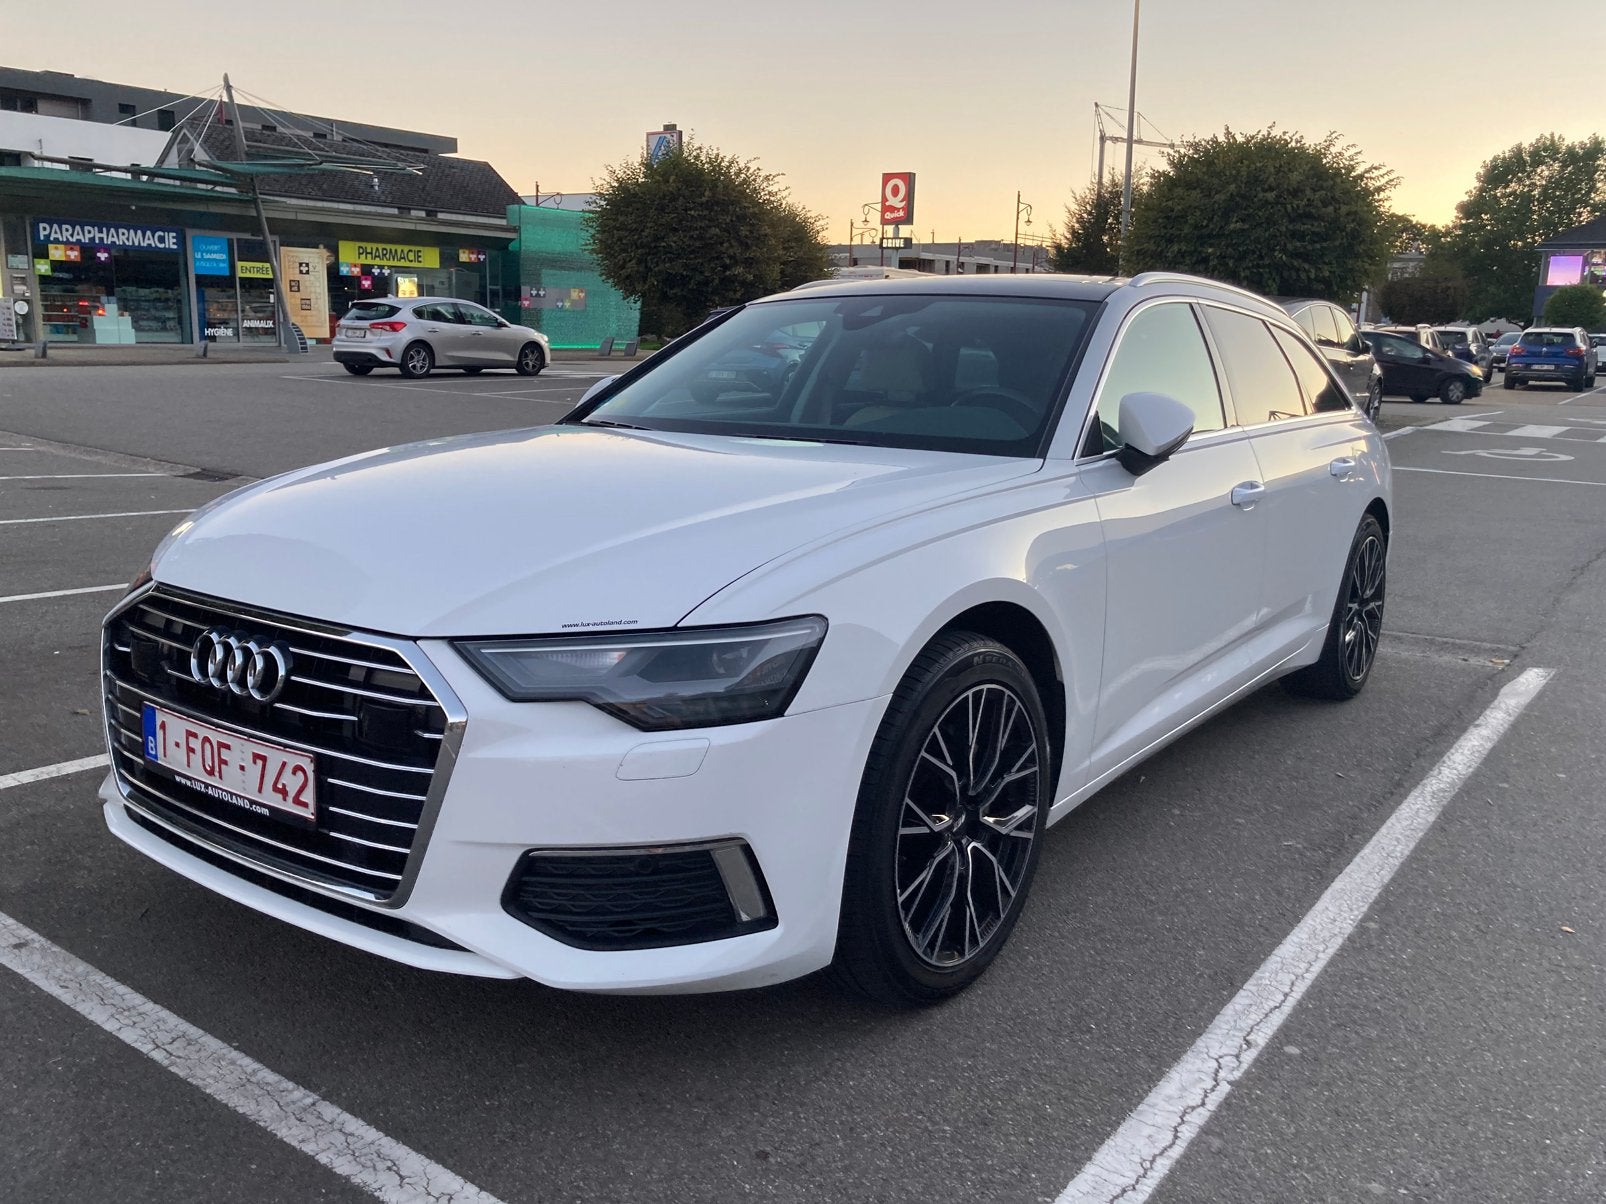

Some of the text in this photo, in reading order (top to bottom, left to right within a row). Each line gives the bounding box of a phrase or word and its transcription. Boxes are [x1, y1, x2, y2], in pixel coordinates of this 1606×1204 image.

[884, 209, 904, 219] Quick
[38, 222, 178, 249] PARAPHARMACIE
[882, 239, 905, 248] DRIVE
[357, 245, 423, 264] PHARMACIE
[240, 264, 270, 276] ENTRÉE
[243, 320, 274, 328] ANIMAUX
[204, 326, 233, 337] HYGIÈNE
[561, 620, 638, 628] www.lux-autoland.com
[148, 736, 156, 755] B
[158, 719, 309, 809] 1-FQF-742
[174, 774, 270, 816] www.LUX-AUTOLAND.com
